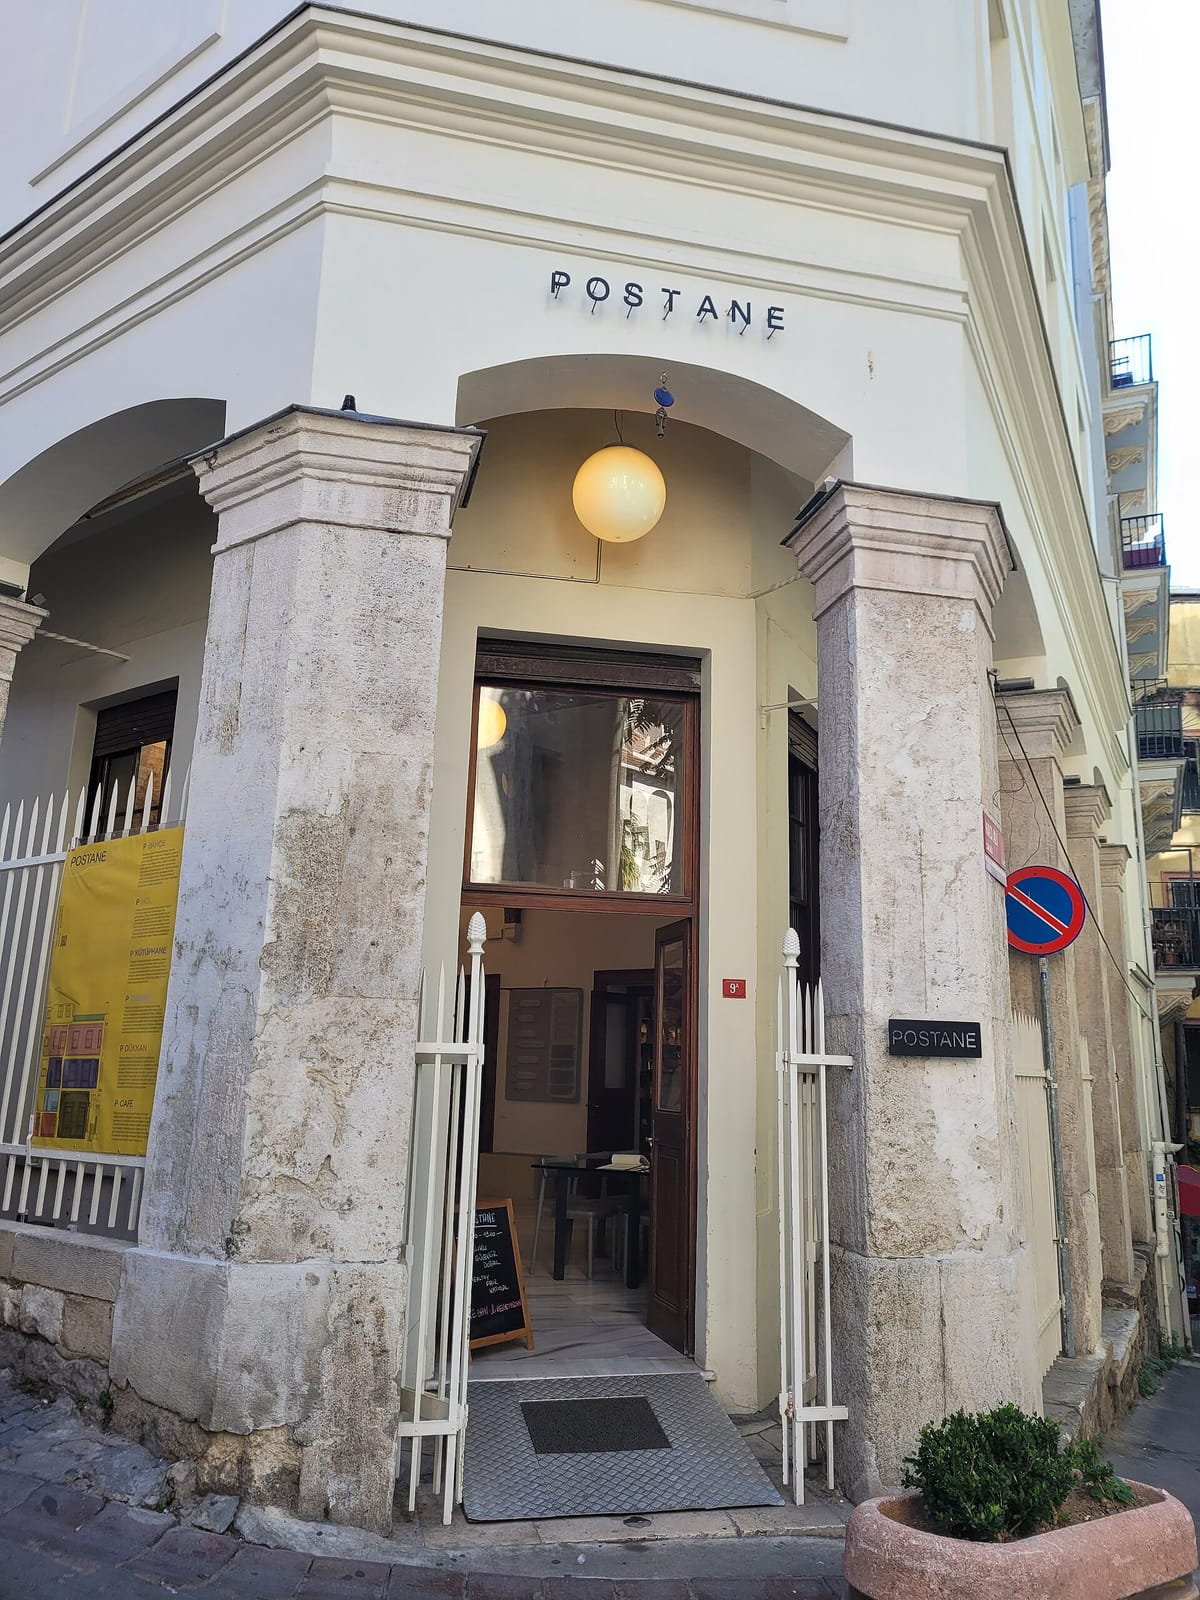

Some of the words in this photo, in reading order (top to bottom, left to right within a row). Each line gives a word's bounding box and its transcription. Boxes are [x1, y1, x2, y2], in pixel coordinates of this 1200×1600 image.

[551, 270, 785, 331] POSTANE
[70, 850, 107, 867] POSTANE
[892, 1029, 977, 1048] POSTANE
